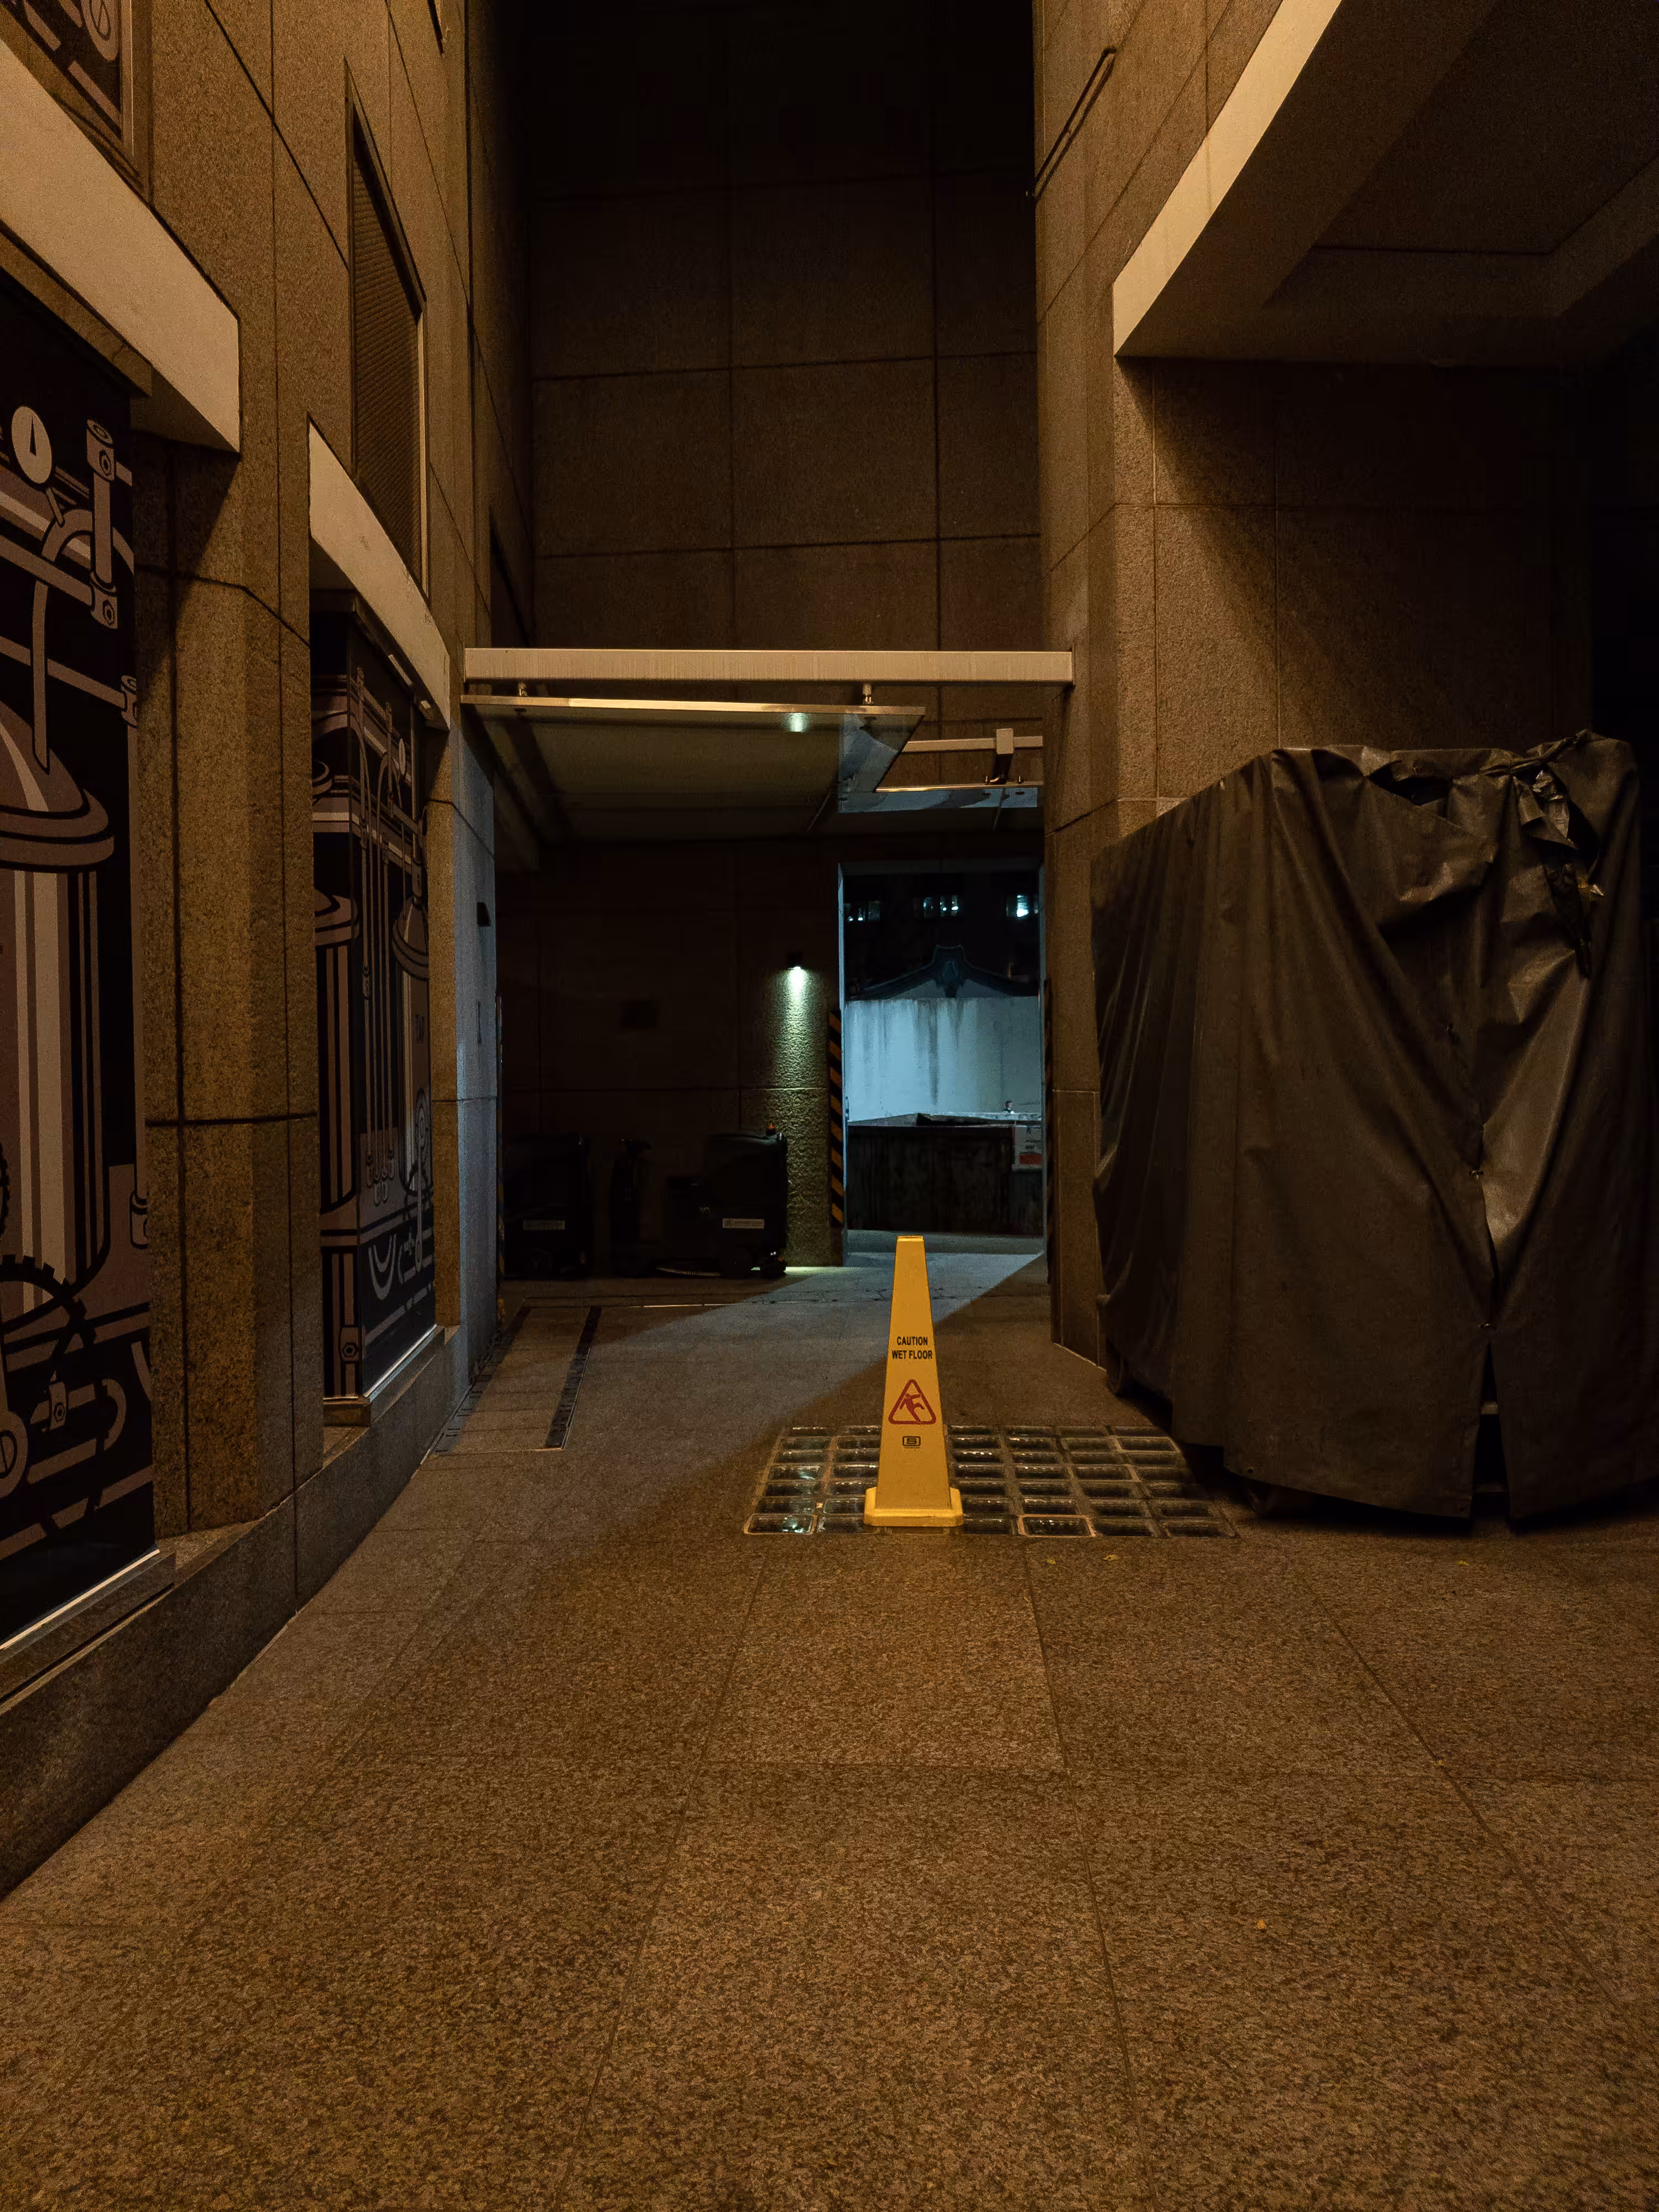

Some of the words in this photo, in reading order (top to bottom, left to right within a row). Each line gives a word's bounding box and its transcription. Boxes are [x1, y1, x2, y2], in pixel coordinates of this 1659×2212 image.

[896, 1336, 928, 1345] CAUTION
[891, 1350, 907, 1359] WET
[909, 1350, 933, 1359] FLOOR
